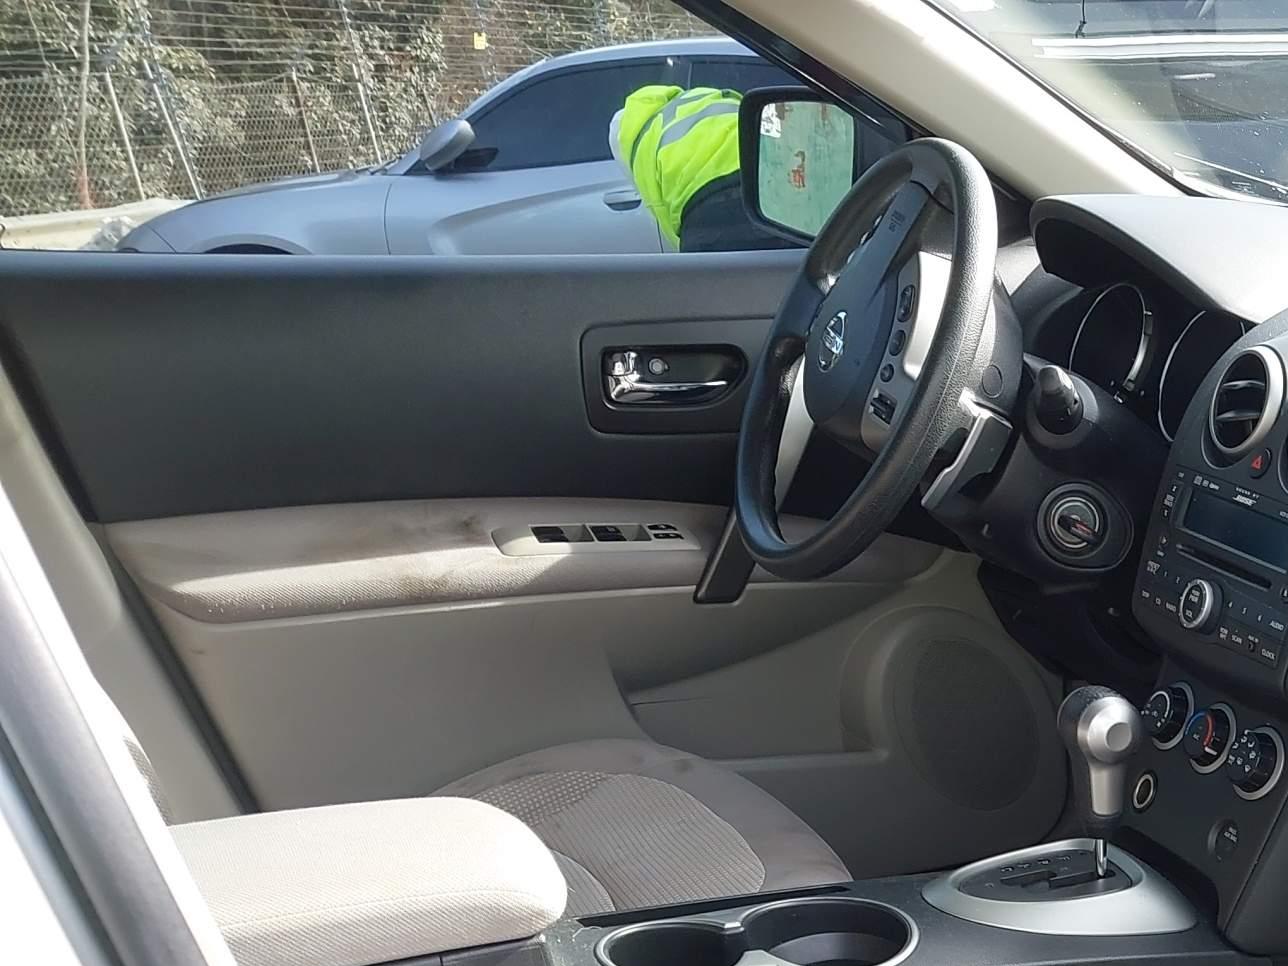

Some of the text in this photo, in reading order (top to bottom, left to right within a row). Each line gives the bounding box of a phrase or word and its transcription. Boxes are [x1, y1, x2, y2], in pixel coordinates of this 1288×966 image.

[1232, 494, 1257, 506] BOSE
[1269, 620, 1285, 631] AUDIO
[1261, 648, 1275, 661] CLOCK
